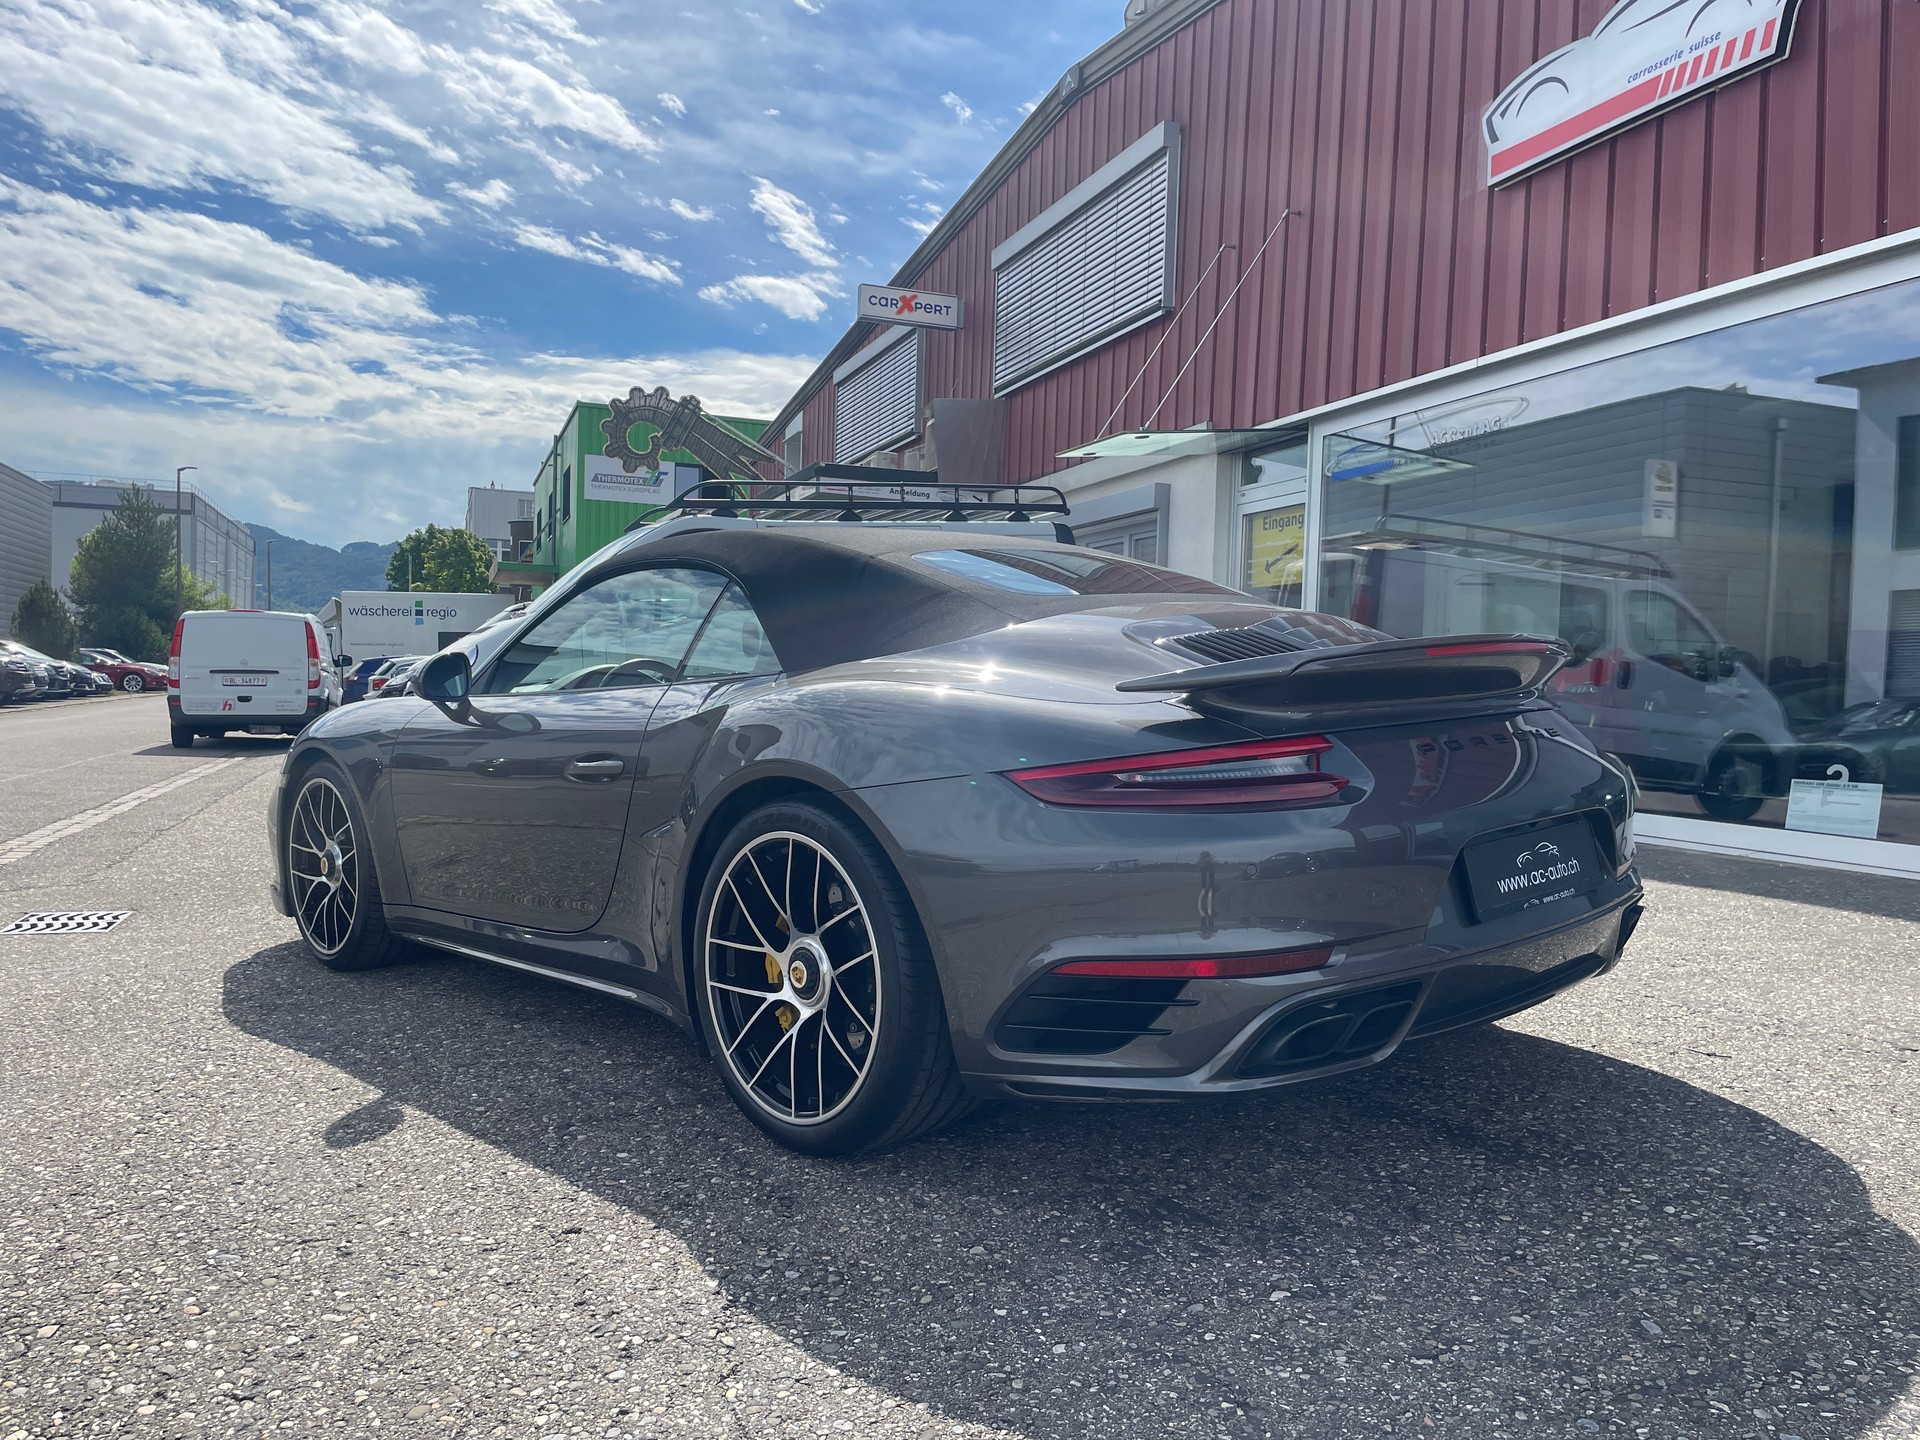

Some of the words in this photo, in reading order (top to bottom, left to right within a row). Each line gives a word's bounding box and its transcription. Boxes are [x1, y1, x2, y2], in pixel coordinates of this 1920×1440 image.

[1627, 49, 1684, 84] carrosserie
[1688, 31, 1721, 54] suisse
[597, 474, 644, 485] THERMOTEX
[591, 483, 627, 492] THERMOTEX
[627, 486, 652, 494] EUROPE
[889, 487, 930, 499] Anmeldung
[1262, 513, 1304, 533] Eingang
[349, 606, 412, 617] wäscherei
[426, 607, 457, 620] regio
[1496, 857, 1581, 894] www.ac-auto.ch
[1542, 887, 1576, 904] www.ac-auto.ch
